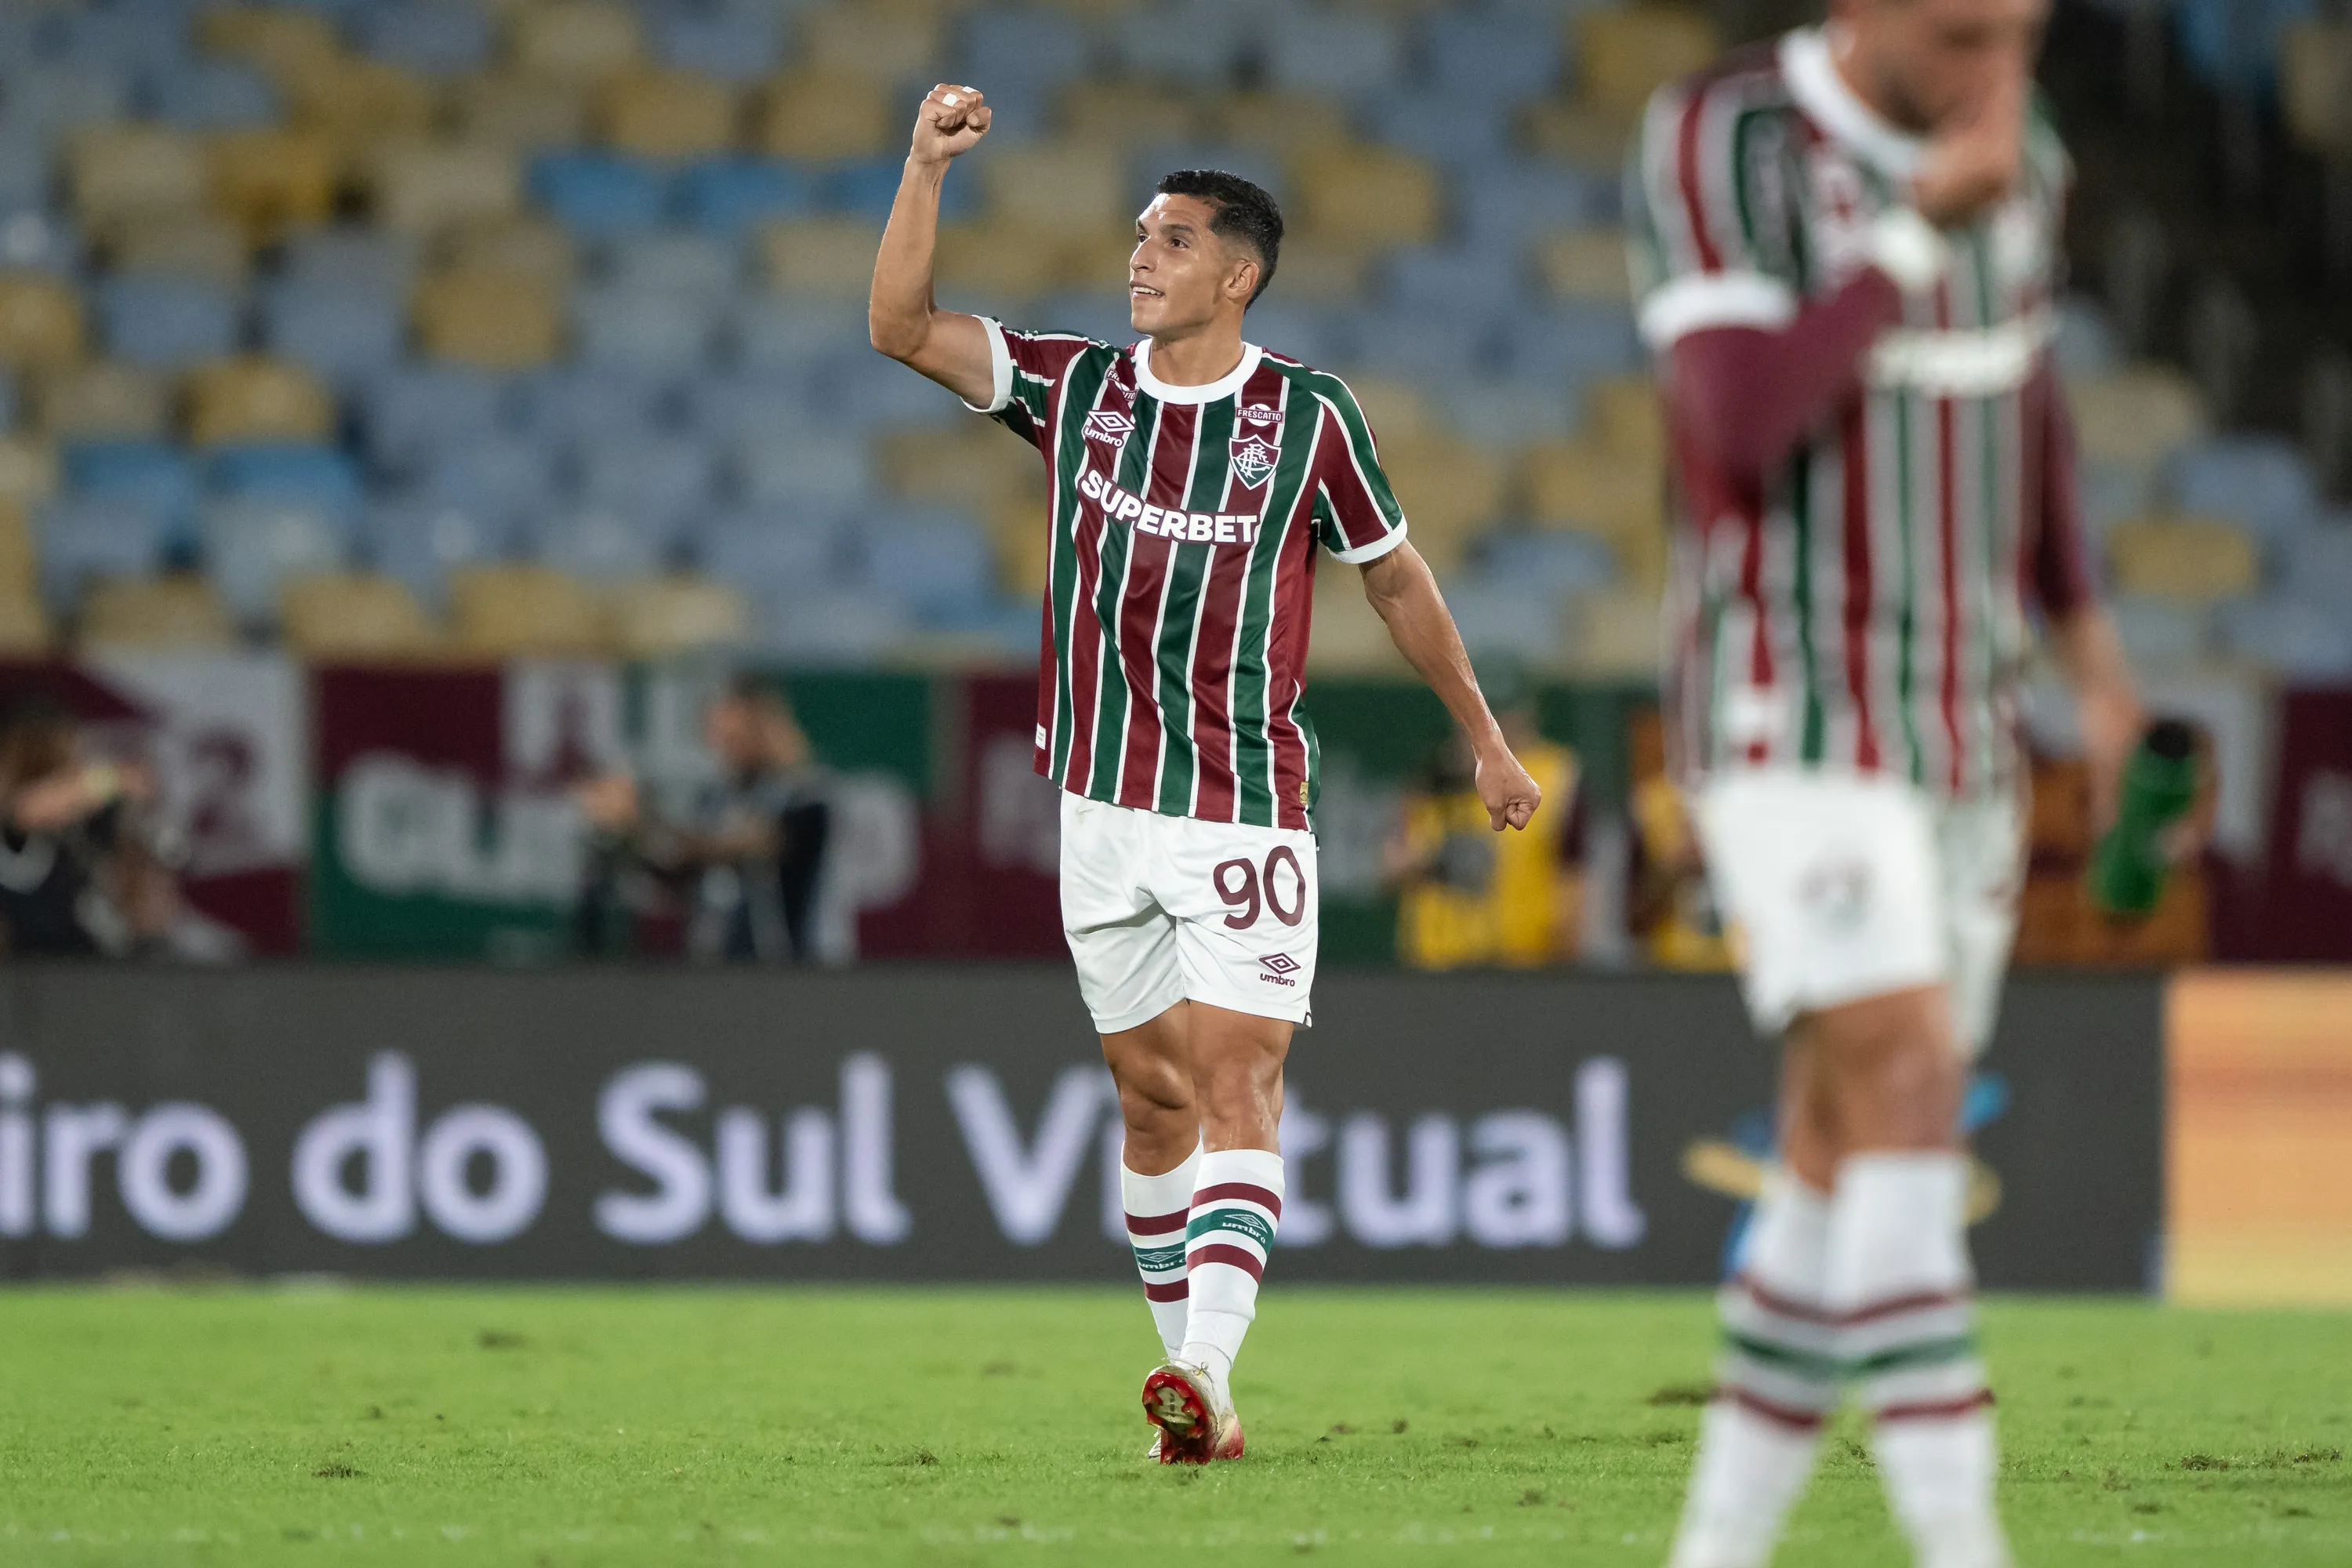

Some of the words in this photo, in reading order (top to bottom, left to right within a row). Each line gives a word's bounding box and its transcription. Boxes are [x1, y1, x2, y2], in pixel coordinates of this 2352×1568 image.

[1237, 408, 1282, 421] FRESCATTO
[1084, 426, 1123, 447] umbro
[1080, 469, 1258, 543] SUPERBET
[1213, 845, 1305, 930] 90
[1259, 973, 1295, 987] umbro
[291, 1051, 547, 1242] do
[593, 1053, 912, 1243] Sul
[1221, 1221, 1266, 1244] umbro
